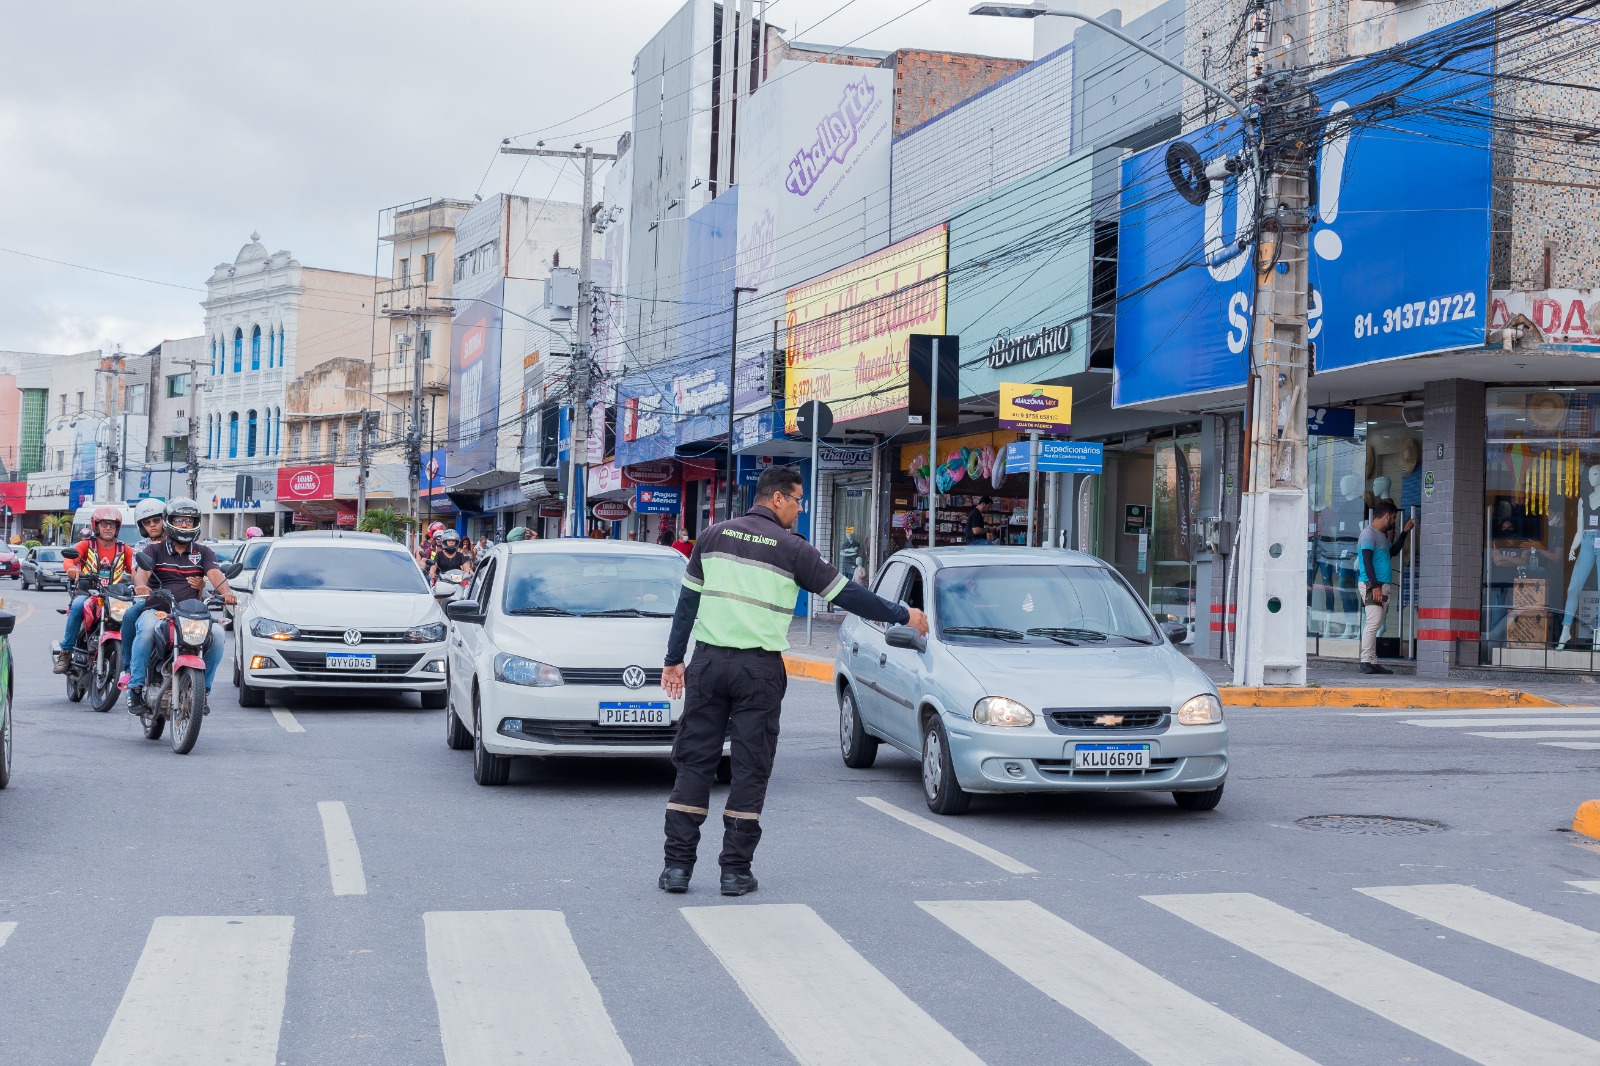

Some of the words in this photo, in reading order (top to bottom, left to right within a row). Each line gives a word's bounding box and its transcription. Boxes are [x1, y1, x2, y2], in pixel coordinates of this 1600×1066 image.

[1044, 444, 1101, 455] Expedicionários
[653, 491, 678, 499] Pague
[721, 528, 744, 540] AGENTE
[743, 533, 752, 542] DE
[606, 709, 663, 723] PDE1A08
[1082, 752, 1143, 766] KLU6G90
